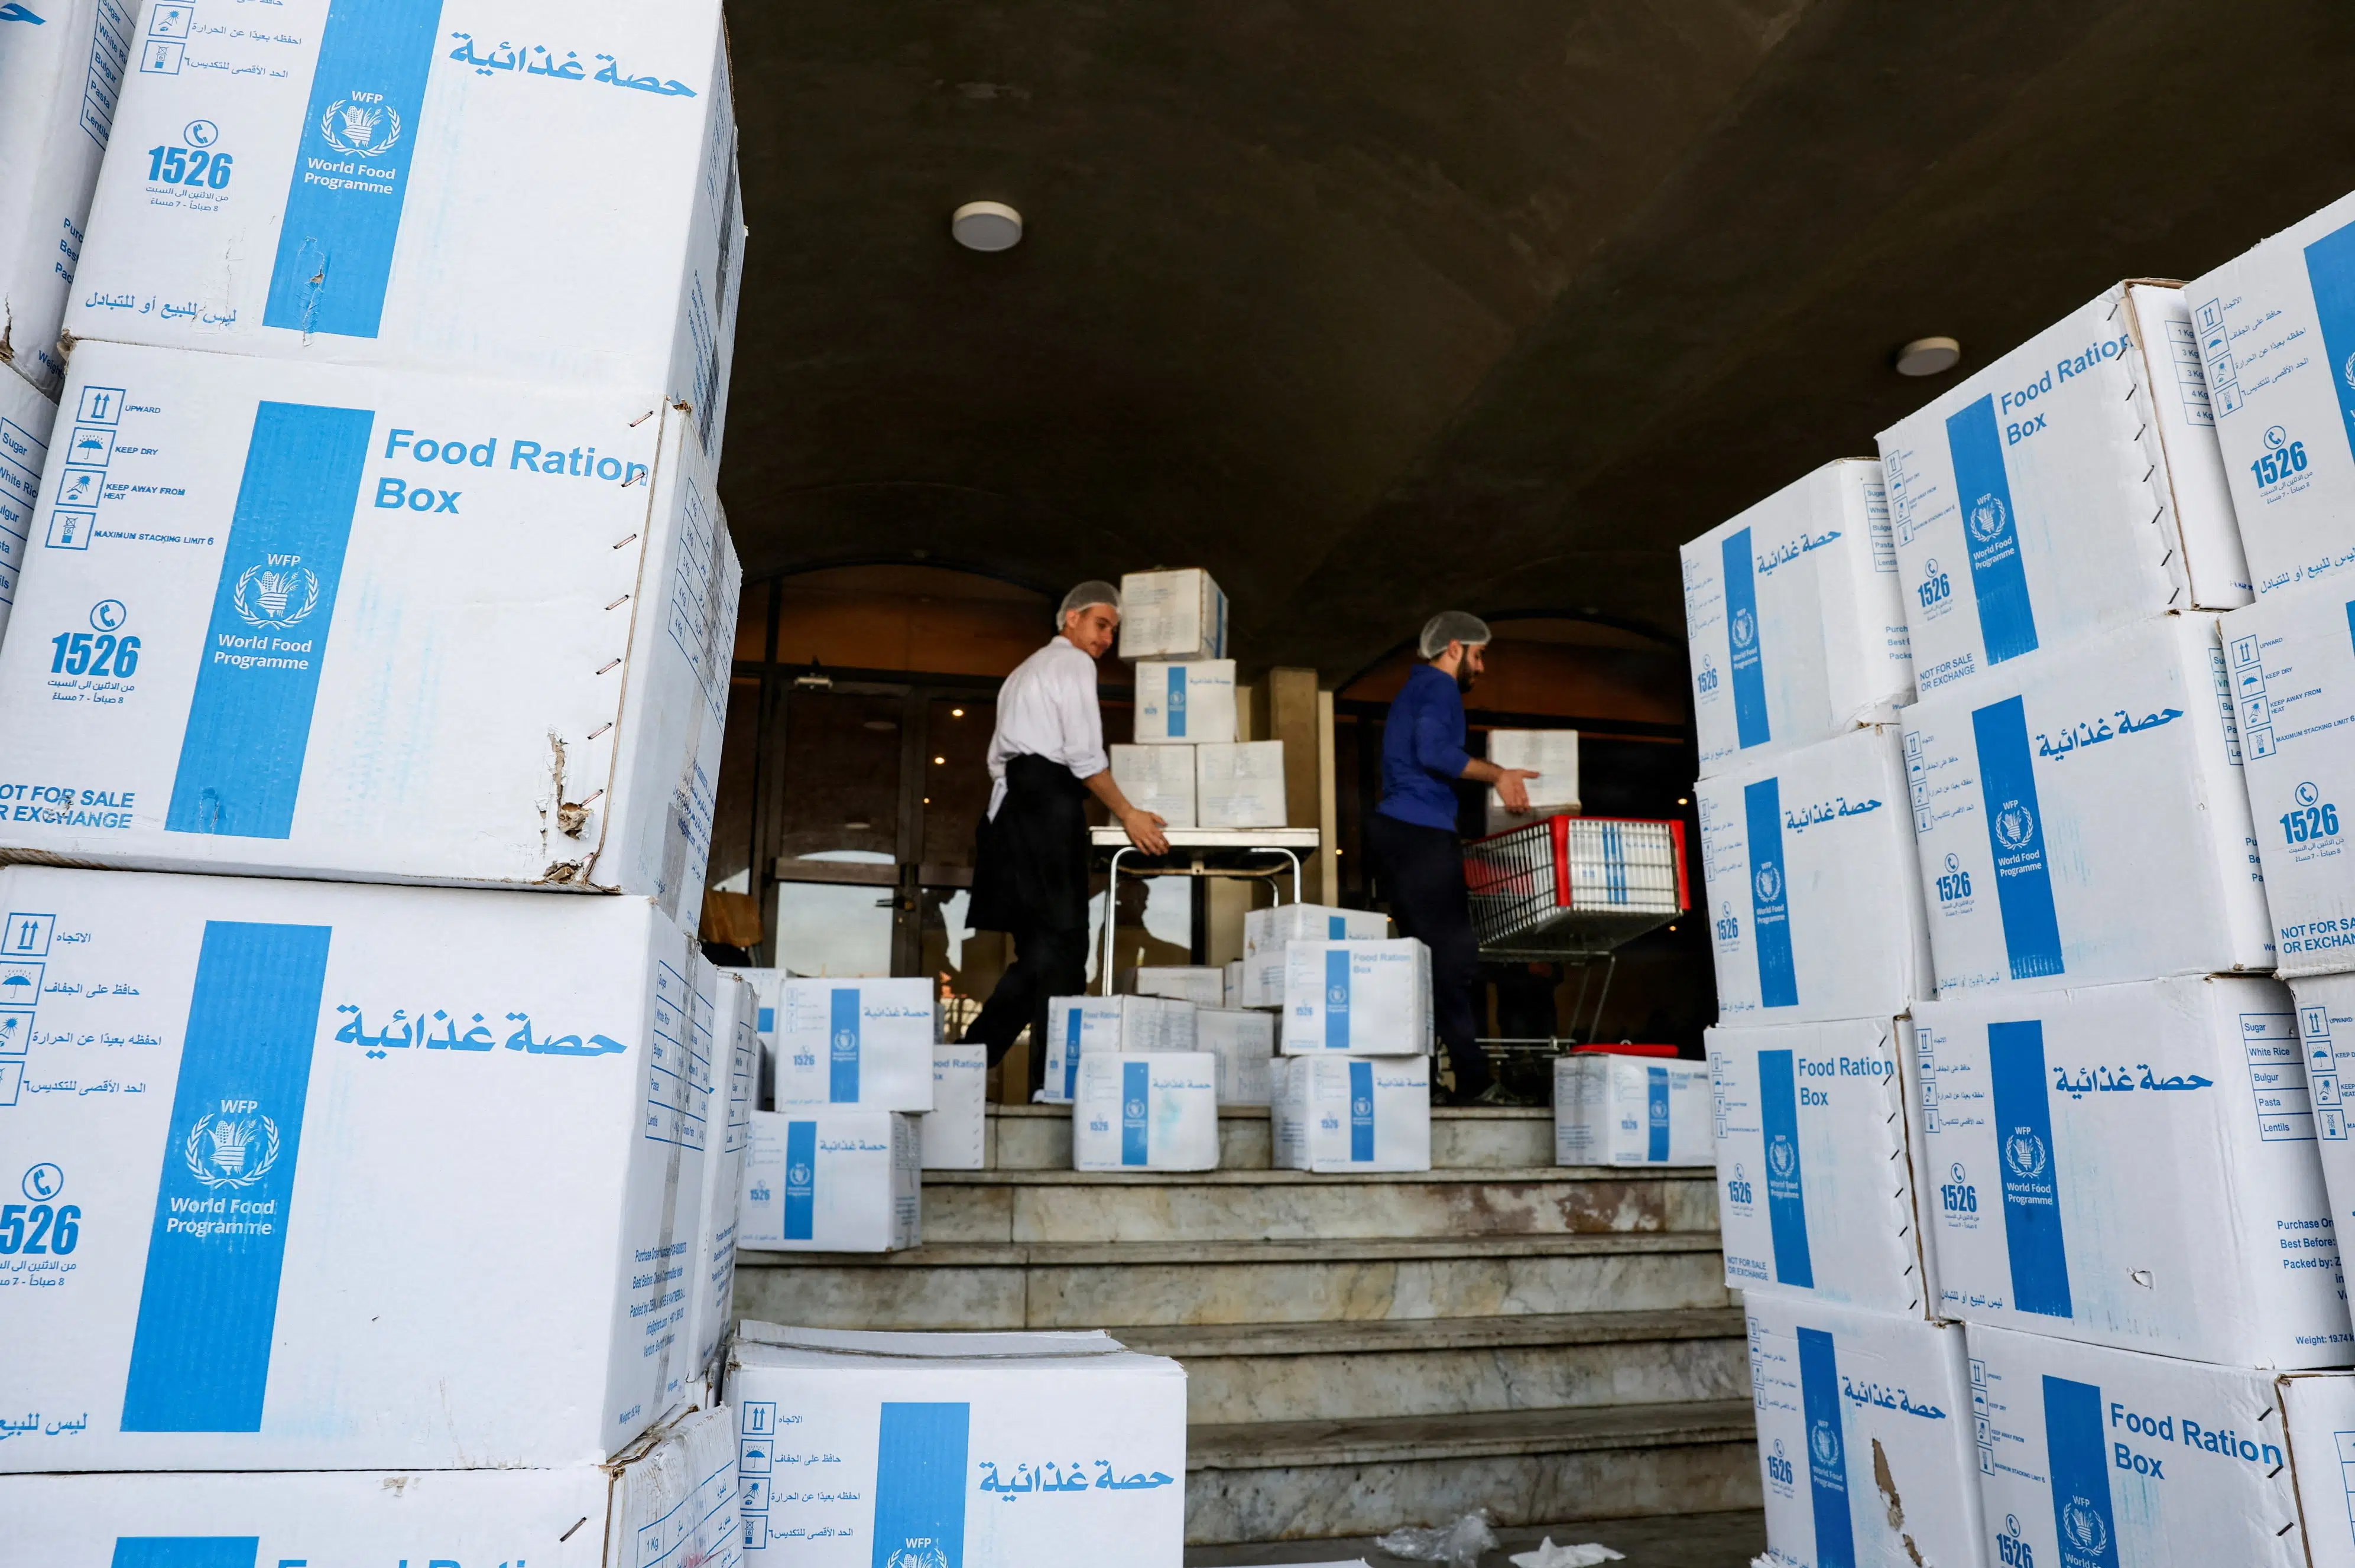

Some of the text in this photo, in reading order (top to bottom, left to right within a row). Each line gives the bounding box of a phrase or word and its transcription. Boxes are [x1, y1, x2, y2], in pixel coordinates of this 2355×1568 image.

[99, 22, 118, 53] White
[192, 22, 301, 45] احفظه بعيدًا عن الحرارة
[95, 52, 116, 83] Bulgur
[449, 32, 698, 98] حصة غذائية
[90, 80, 110, 109] Pasta
[352, 90, 384, 104] WFP
[86, 109, 109, 141] Lentils
[148, 145, 233, 190] 1526
[307, 157, 396, 180] World Food
[304, 173, 393, 194] Programme
[85, 291, 237, 327] ليس للبيع أو للتبادل
[2001, 333, 2134, 415] Food Ration
[125, 405, 161, 414] UPWARD
[2006, 413, 2047, 446] Box
[2, 432, 28, 456] Sugar
[384, 428, 649, 486] Food Ration
[2250, 441, 2308, 489] 1526
[131, 485, 158, 494] AWAY
[159, 487, 186, 496] FROM
[374, 477, 462, 514] Box
[1976, 492, 1992, 505] WFP
[94, 530, 214, 546] MAXIMUM STACKING LIMIT 6
[1973, 535, 2013, 560] World Food
[267, 553, 301, 566] WFP
[1757, 531, 1842, 576] حصة غذائية
[1975, 547, 2015, 570] Programme
[1917, 573, 1950, 608] 1526
[219, 634, 313, 652] World Food
[2259, 637, 2283, 649] UPWARD
[51, 632, 141, 679] 1526
[214, 651, 309, 670] Programme
[1919, 652, 1975, 681] NOT FOR SALE
[2265, 667, 2292, 680] KEEP DRY
[1697, 667, 1718, 693] 1526
[1921, 664, 1976, 692] OR EXCHANGE
[2270, 687, 2322, 708] KEEP AWAY FROM
[2270, 706, 2285, 715] HEAT
[2035, 709, 2184, 762] حصة غذائية
[2275, 731, 2303, 743] MAXIMUM
[2303, 722, 2333, 735] STACKING
[2333, 718, 2349, 726] LIMIT
[30, 785, 135, 809] FOR SALE
[2003, 799, 2019, 810] WFP
[12, 806, 133, 829] EXCHANGE
[1785, 797, 1882, 833] حصة غذائية
[2279, 803, 2339, 844] 1526
[1997, 849, 2041, 866] World Food
[2000, 862, 2042, 877] Programme
[1936, 871, 1971, 902] 1526
[56, 932, 91, 944] الاتجاه
[1716, 917, 1738, 940] 1526
[2281, 920, 2338, 939] NOT FOR
[1352, 953, 1411, 962] Food Ration
[2283, 941, 2302, 954] OR
[1352, 965, 1372, 973] Box
[44, 982, 140, 998] حافظ على الجفاف
[659, 973, 667, 991] Sugar
[864, 1007, 930, 1018] حصة غذائية
[335, 1004, 628, 1060] حصة غذائية
[2244, 1022, 2266, 1033] Sugar
[653, 1043, 663, 1059] Bulgur
[793, 1054, 815, 1066] 1526
[2249, 1047, 2290, 1056] White Rice
[952, 1059, 984, 1068] Ration
[1798, 1056, 1895, 1080] Food Ration
[651, 1078, 660, 1092] Pasta
[2053, 1064, 2214, 1100] حصة غذائية
[2253, 1073, 2279, 1083] Bulgur
[1800, 1087, 1828, 1106] Box
[2258, 1098, 2281, 1106] Pasta
[221, 1099, 258, 1115] WFP
[648, 1112, 658, 1128] Lentils
[2263, 1122, 2290, 1132] Lentils
[2015, 1127, 2031, 1135] WFP
[750, 1189, 771, 1201] 1526
[1728, 1179, 1752, 1205] 1526
[2006, 1182, 2051, 1193] World Food
[170, 1197, 275, 1216] World Food
[1941, 1184, 1977, 1213] 1526
[2007, 1193, 2053, 1206] Programme
[166, 1215, 273, 1238] Programme
[2276, 1219, 2320, 1230] Purchase
[2280, 1237, 2335, 1249] Best Before:
[2283, 1257, 2333, 1270] Packed by:
[2295, 1333, 2348, 1346] Weight: 19.74
[1842, 1376, 1947, 1419] حصة غذائية
[45, 1413, 88, 1436] ليس
[778, 1416, 803, 1425] الاتجاه
[2110, 1402, 2283, 1466] Food Ration
[774, 1453, 842, 1466] حافظ على الجفاف
[2114, 1442, 2165, 1480] Box
[1767, 1455, 1793, 1486] 1526
[979, 1460, 1175, 1502] حصة غذائية
[906, 1537, 932, 1548] WFP
[1996, 1531, 2033, 1568] 1526
